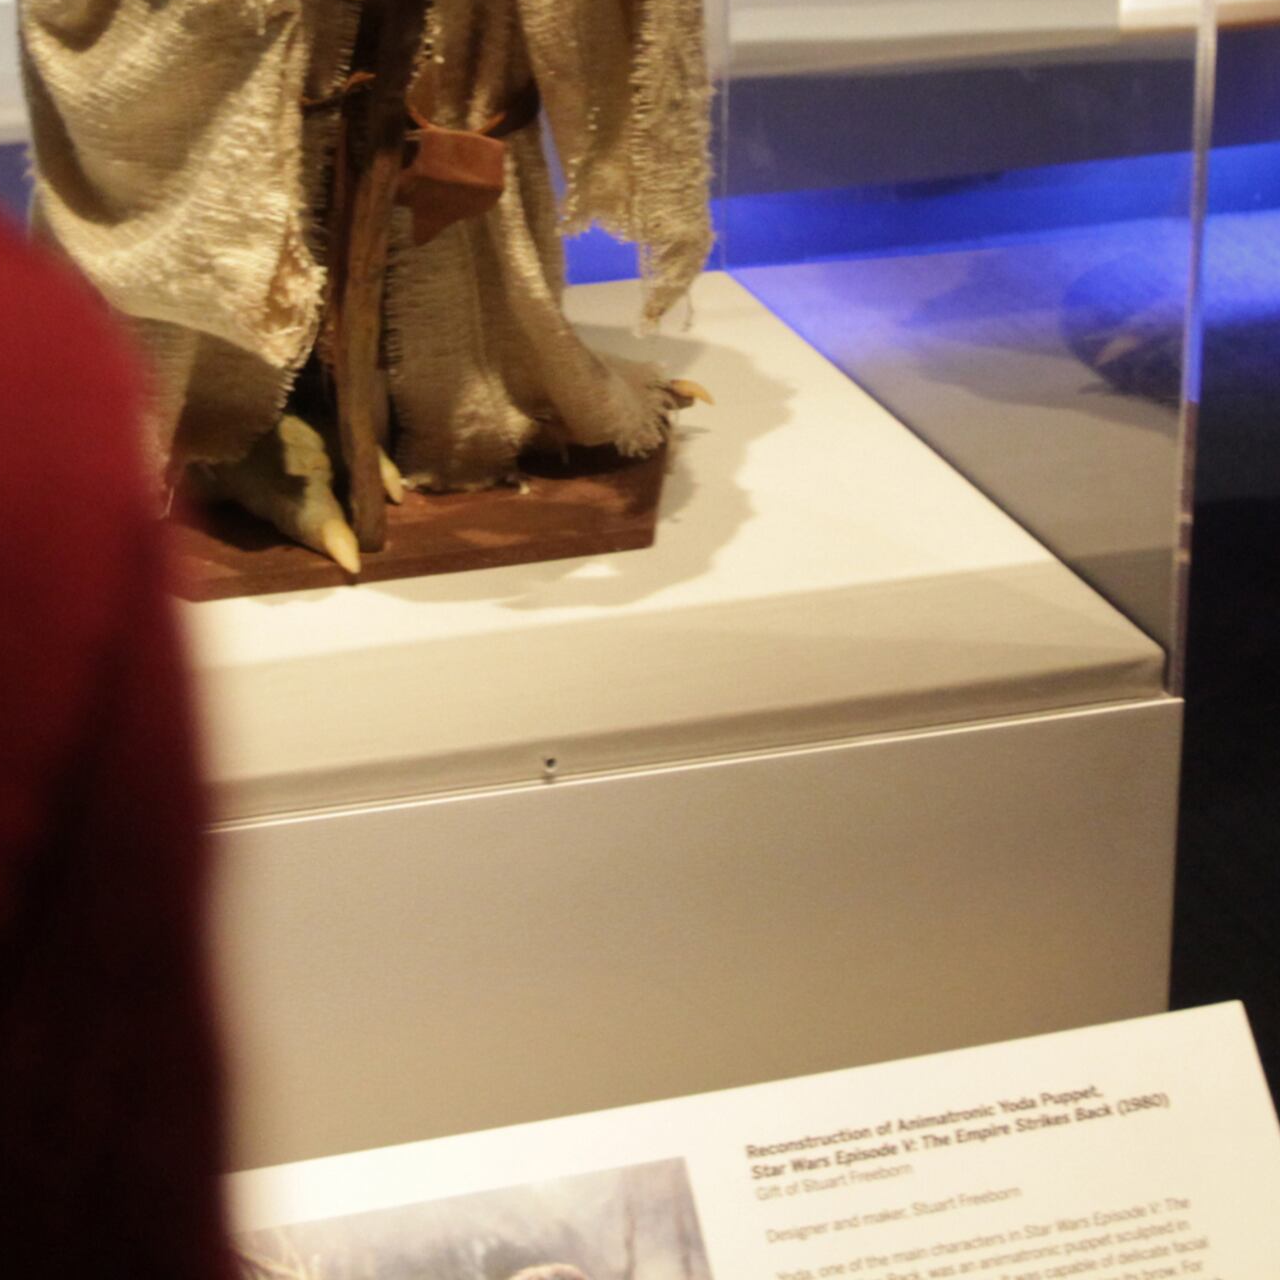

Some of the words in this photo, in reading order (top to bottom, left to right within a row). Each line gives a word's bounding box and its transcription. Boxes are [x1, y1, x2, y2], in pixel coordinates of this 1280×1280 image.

[745, 1124, 871, 1158] Reconstruction
[876, 1121, 893, 1136] of
[897, 1104, 996, 1132] Animatronic
[998, 1097, 1037, 1114] Yoda
[1040, 1085, 1103, 1106] Puppet,
[751, 1162, 786, 1180] Star
[790, 1155, 831, 1173] Wars
[835, 1143, 898, 1167] Episode
[902, 1138, 918, 1153] V:
[921, 1132, 951, 1151] The
[955, 1123, 1011, 1144] Empire
[1015, 1112, 1070, 1133] Strikes
[1075, 1103, 1113, 1122] Back
[1117, 1092, 1170, 1116] (1980)
[756, 1184, 782, 1202] Gift
[785, 1182, 799, 1197] of
[802, 1175, 847, 1193] Stuart
[848, 1164, 913, 1182] Freeborn
[766, 1222, 829, 1244] Designer
[833, 1215, 860, 1231] and
[912, 1197, 956, 1216] Stuart
[958, 1187, 1022, 1207] Freeborn
[818, 1263, 846, 1278] one
[849, 1257, 863, 1273] of
[865, 1254, 890, 1269] the
[892, 1248, 928, 1264] main
[930, 1232, 1006, 1257] characters
[1008, 1229, 1022, 1241] in
[1024, 1223, 1052, 1240] Star
[1055, 1217, 1089, 1232] Wars
[1092, 1206, 1147, 1227] Episode
[1164, 1197, 1191, 1211] The
[1064, 1234, 1113, 1256] puppet
[1116, 1221, 1174, 1243] sculpted
[1176, 1219, 1190, 1231] in
[1100, 1253, 1114, 1268] of
